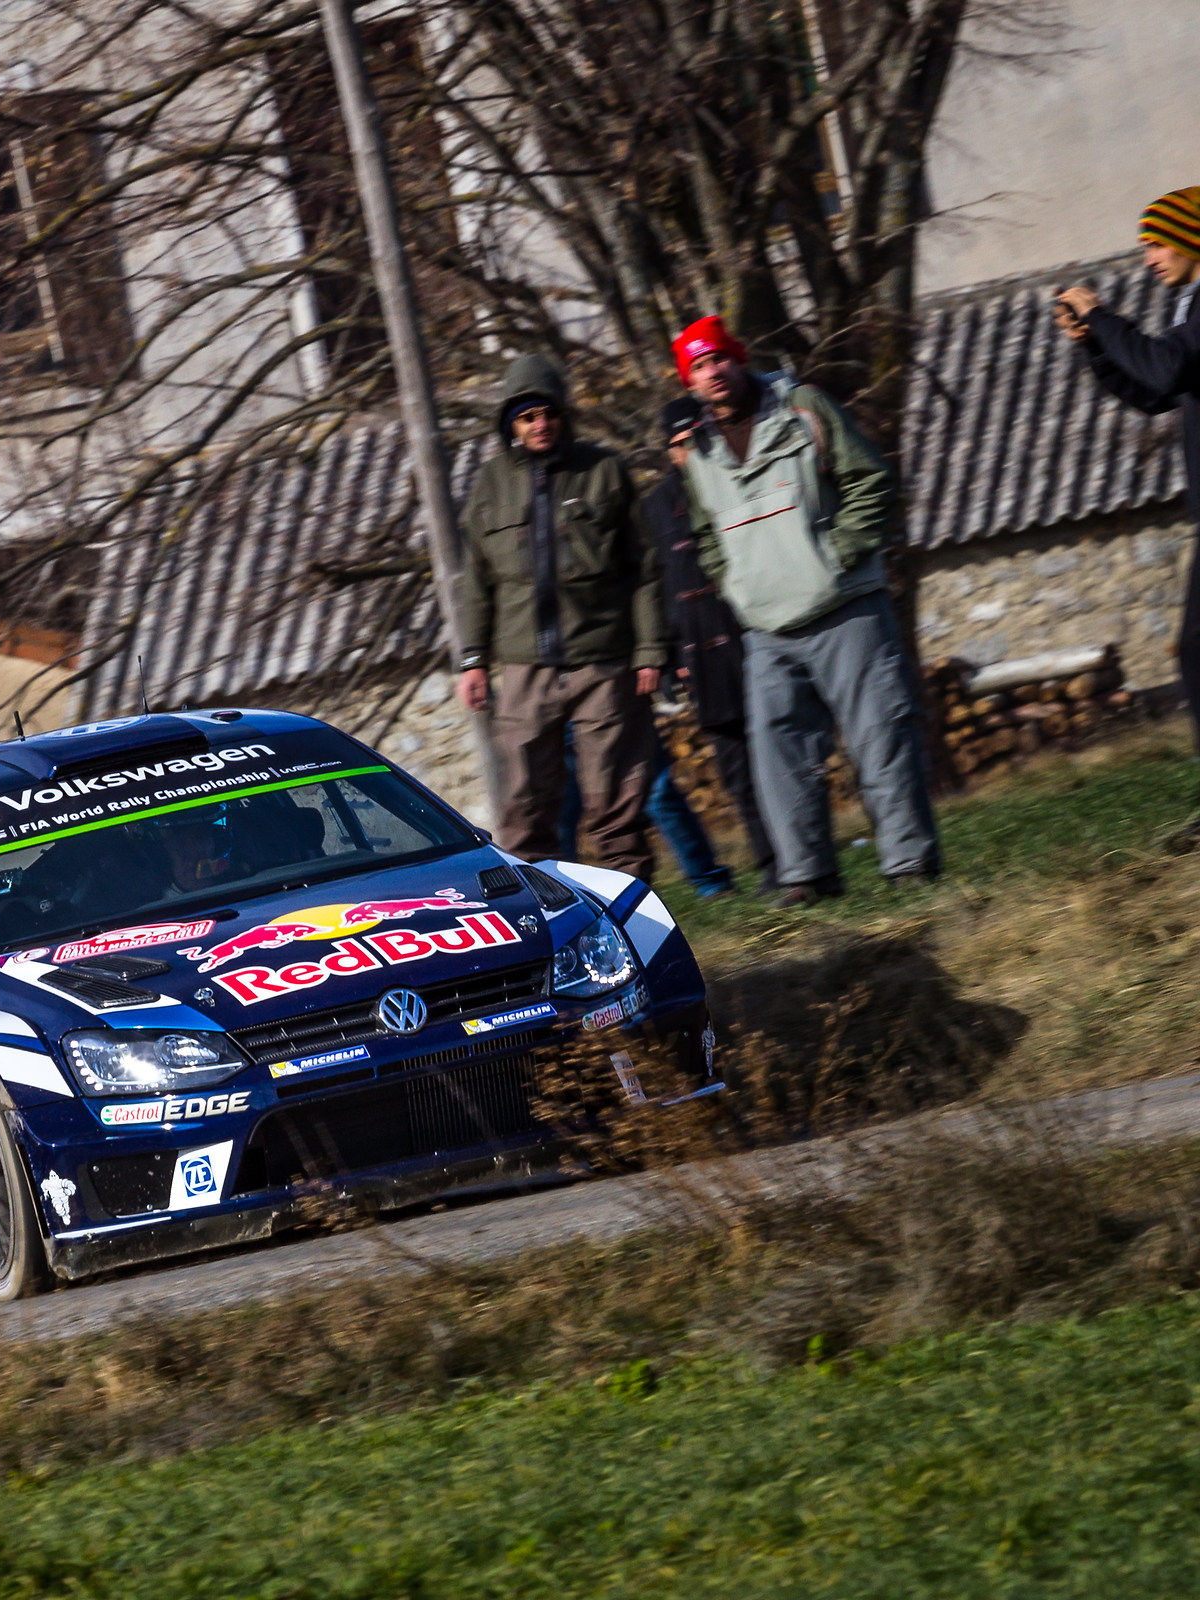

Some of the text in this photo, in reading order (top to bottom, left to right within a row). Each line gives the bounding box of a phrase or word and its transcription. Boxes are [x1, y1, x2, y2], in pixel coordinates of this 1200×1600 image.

[19, 819, 50, 834] FIA
[51, 805, 104, 825] World
[107, 795, 150, 812] Rally
[153, 771, 271, 800] Championship
[217, 911, 519, 1003] Red Bull
[491, 1005, 551, 1026] MICHELIN
[593, 1002, 623, 1028] Castrol
[300, 1047, 365, 1069] MICHELIN
[114, 1091, 252, 1123] Castrol EDGE
[185, 1163, 212, 1189] ZF
